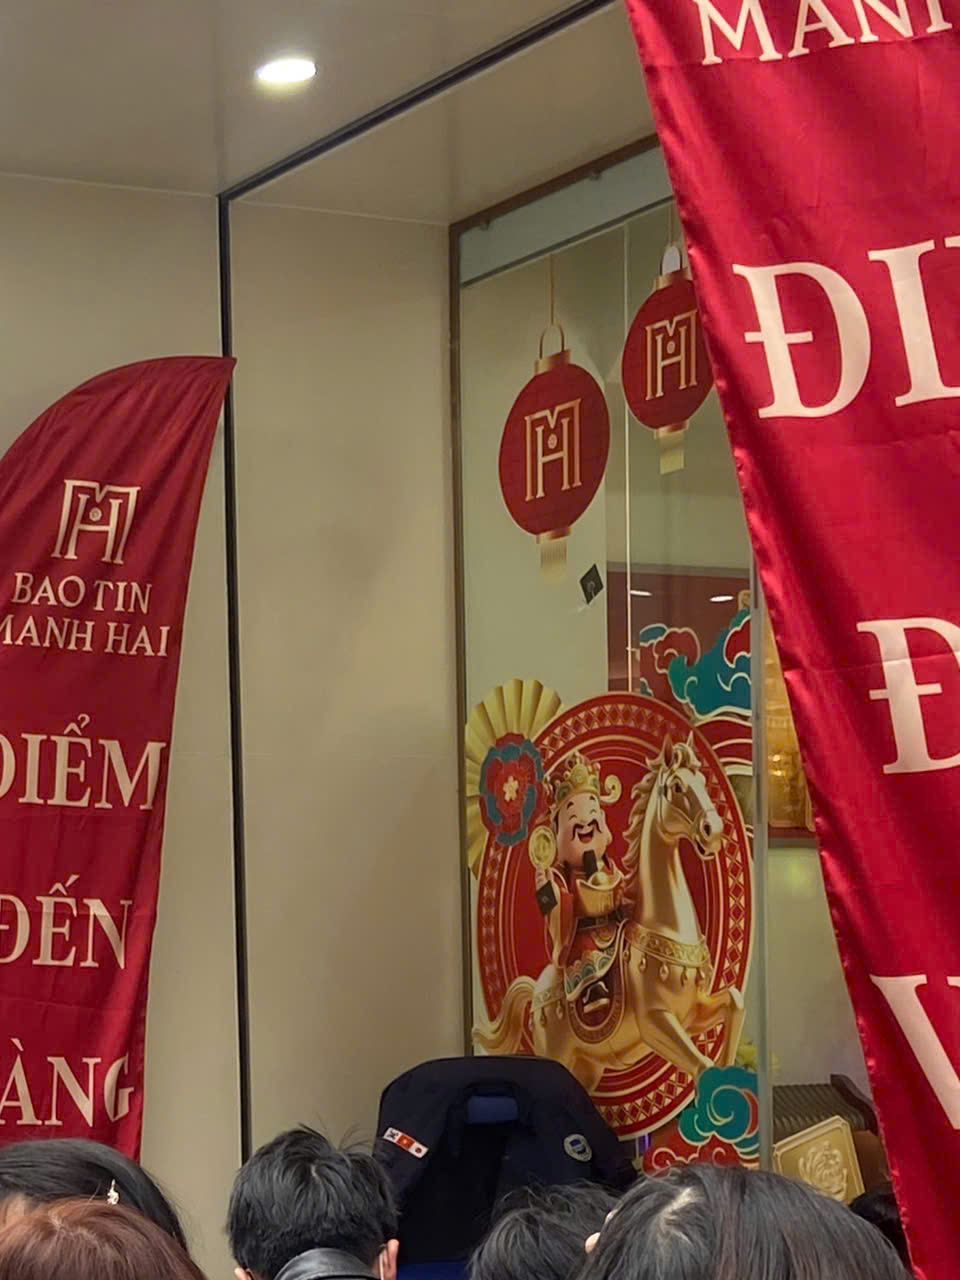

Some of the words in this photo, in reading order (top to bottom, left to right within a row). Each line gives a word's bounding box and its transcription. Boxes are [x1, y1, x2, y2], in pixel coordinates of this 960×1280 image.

[693, 0, 953, 66] MAN
[732, 236, 960, 418] ĐI
[11, 572, 86, 607] BAO
[93, 580, 152, 614] TIN
[104, 621, 171, 657] HAI
